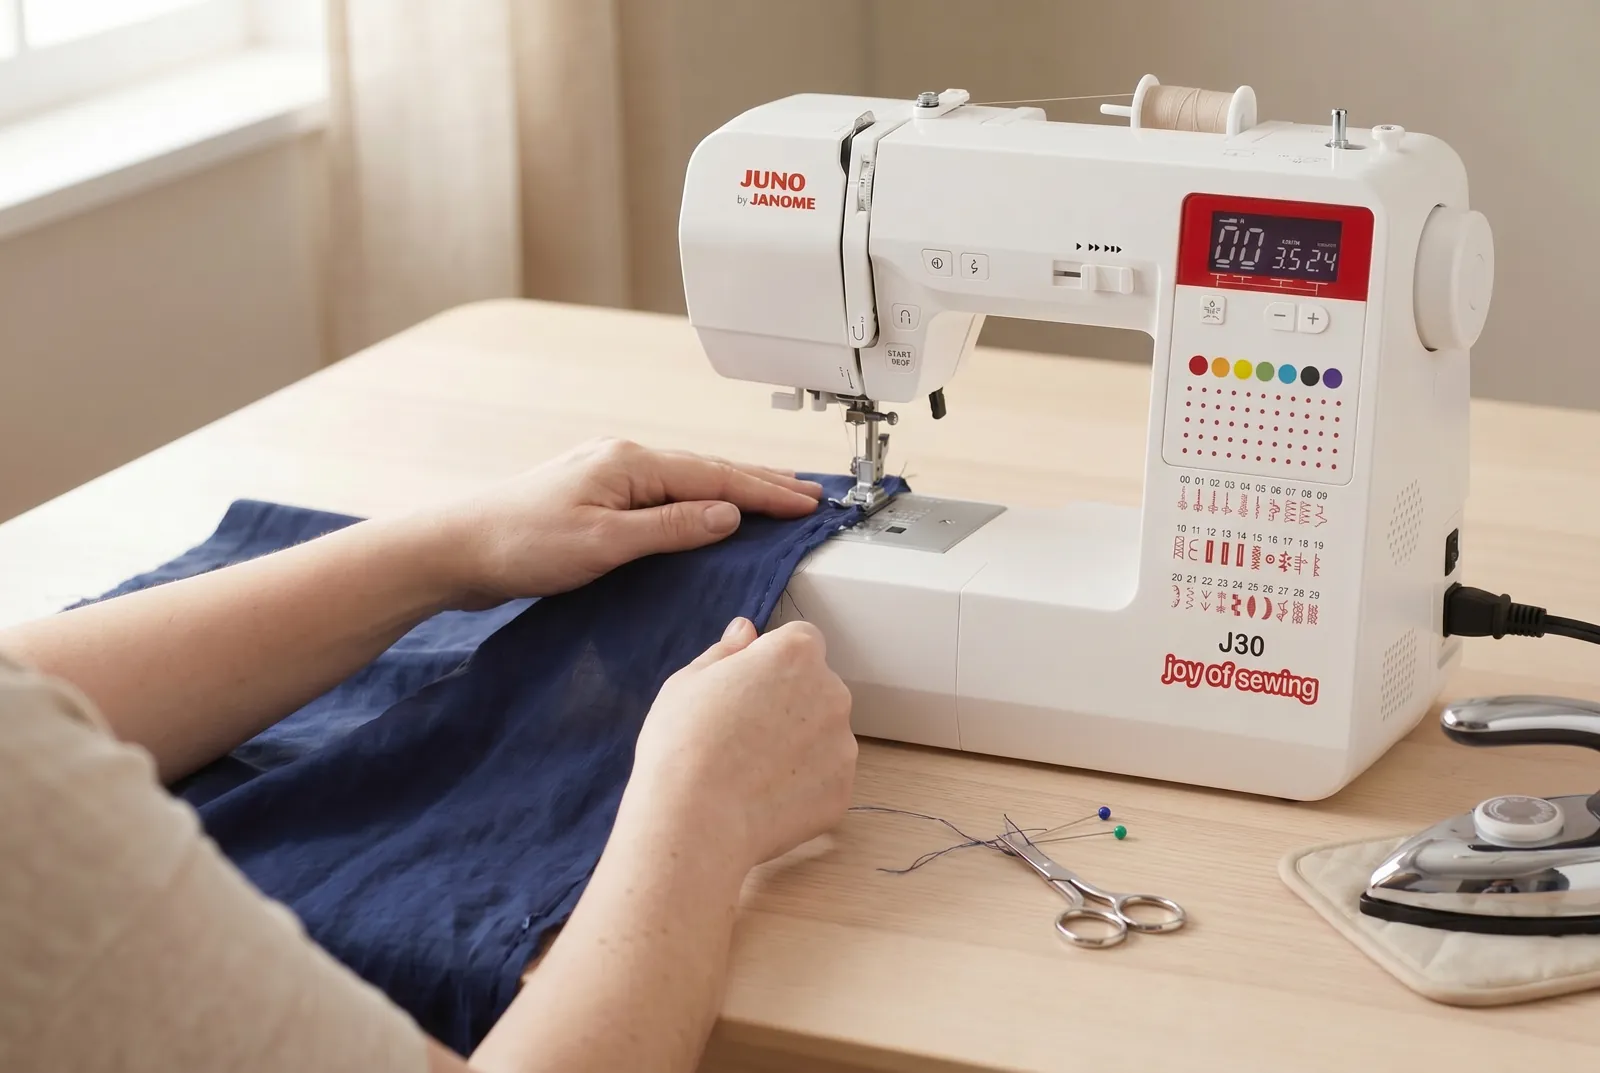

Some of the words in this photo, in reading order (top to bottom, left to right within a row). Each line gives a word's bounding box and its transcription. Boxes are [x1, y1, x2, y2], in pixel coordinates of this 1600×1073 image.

[740, 169, 806, 192] JUNO
[737, 194, 748, 207] by
[749, 193, 816, 210] JANOME
[1214, 225, 1265, 267] 00
[1272, 246, 1302, 271] 3.5
[1305, 249, 1337, 272] 2.4
[887, 349, 911, 358] START
[1180, 475, 1190, 484] 00
[1194, 476, 1204, 486] 01
[1210, 478, 1220, 488] 02
[1225, 480, 1235, 489] 03
[1240, 482, 1250, 491] 04
[1255, 484, 1266, 493] 05
[1270, 485, 1281, 495] 06
[1285, 487, 1296, 497] 07
[1301, 489, 1312, 499] 08
[1316, 491, 1328, 500] 09
[1176, 524, 1187, 533] 10
[1192, 526, 1200, 535] 11
[1206, 527, 1217, 537] 12
[1221, 529, 1232, 539] 13
[1237, 531, 1247, 540] 14
[1252, 533, 1263, 543] 15
[1268, 535, 1278, 544] 16
[1283, 537, 1293, 546] 17
[1298, 539, 1309, 548] 18
[1314, 541, 1324, 550] 19
[1171, 573, 1183, 582] 20
[1186, 575, 1197, 584] 21
[1201, 576, 1213, 586] 22
[1217, 578, 1228, 588] 23
[1232, 580, 1243, 590] 24
[1247, 582, 1259, 592] 25
[1262, 584, 1274, 594] 26
[1278, 586, 1289, 595] 27
[1293, 588, 1305, 598] 28
[1308, 590, 1320, 600] 29
[1218, 631, 1265, 657] J30
[1162, 654, 1203, 687] joy
[1206, 662, 1234, 688] of
[1236, 669, 1318, 704] sewing
